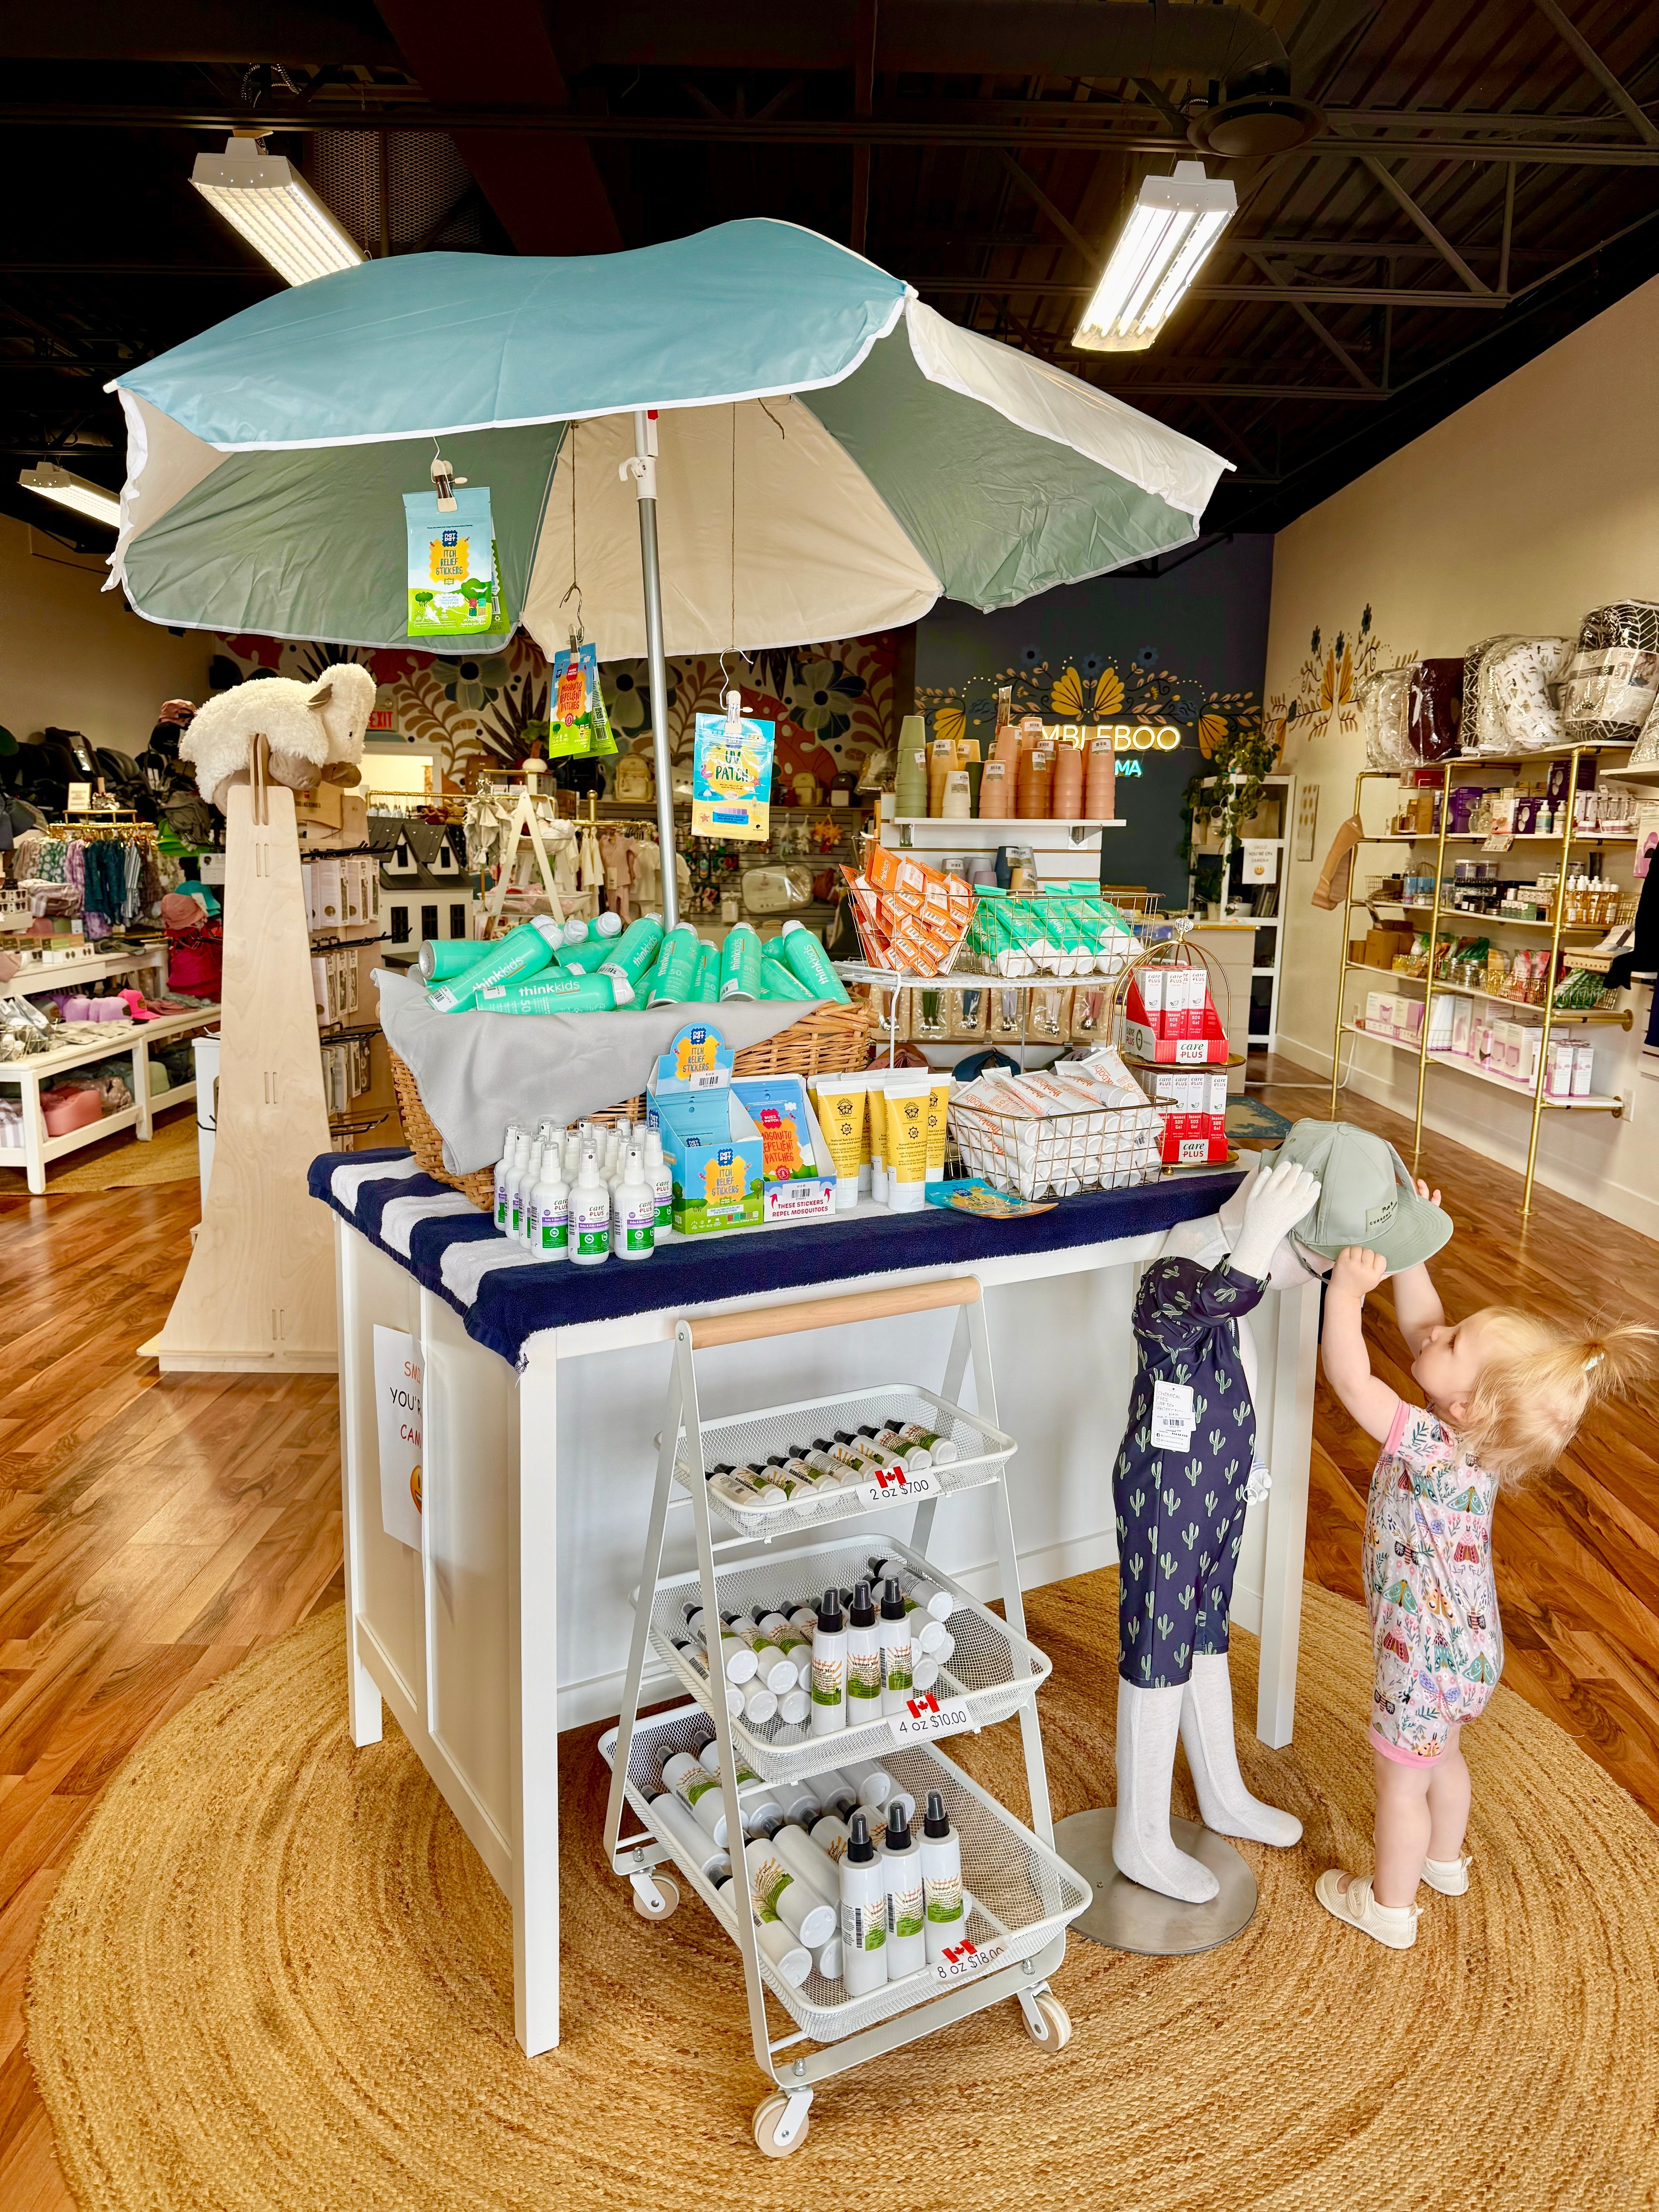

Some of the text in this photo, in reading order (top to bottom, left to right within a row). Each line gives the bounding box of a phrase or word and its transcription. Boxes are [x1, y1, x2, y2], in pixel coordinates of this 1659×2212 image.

[441, 558, 458, 567] RELIEF
[436, 567, 463, 575] STICKERS
[562, 682, 582, 692] MOSQUITO
[560, 690, 581, 704] REPELLENT
[561, 701, 579, 712] PATCHES
[369, 711, 393, 728] EXIT
[1042, 725, 1180, 751] MBLEBOO
[725, 750, 741, 764] UV
[716, 766, 748, 782] PATCH
[1115, 759, 1142, 776] MA
[633, 935, 658, 967] thinkkids
[730, 938, 742, 971] thinkkids
[657, 941, 673, 977] thinkkids
[804, 945, 829, 985] thinkkids
[472, 956, 523, 992] thinkkids
[519, 980, 580, 996] thinkkids
[520, 999, 531, 1012] 50
[1126, 1036, 1134, 1046] PLUS
[688, 1055, 705, 1064] RELIEF
[683, 1063, 709, 1072] STICKERS
[1029, 1076, 1063, 1097] thinkbaby
[996, 1099, 1006, 1108] 50
[763, 1140, 793, 1154] EPELLENT
[764, 1152, 794, 1164] PATCHES
[720, 1168, 732, 1177] ITCH
[716, 1177, 734, 1186] RELIEF
[712, 1185, 739, 1196] STICKERS
[797, 1199, 824, 1207] STICKERS
[791, 1206, 828, 1215] MOSQUITOES
[404, 1361, 421, 1384] SMI
[390, 1387, 422, 1417] YOU'R
[1158, 1391, 1181, 1399] CHEMICAL
[400, 1424, 421, 1449] CAM
[870, 1480, 929, 1500] 2 oz $7.00
[900, 1711, 967, 1733] 4 oz $10.00
[938, 1966, 946, 1978] 8
